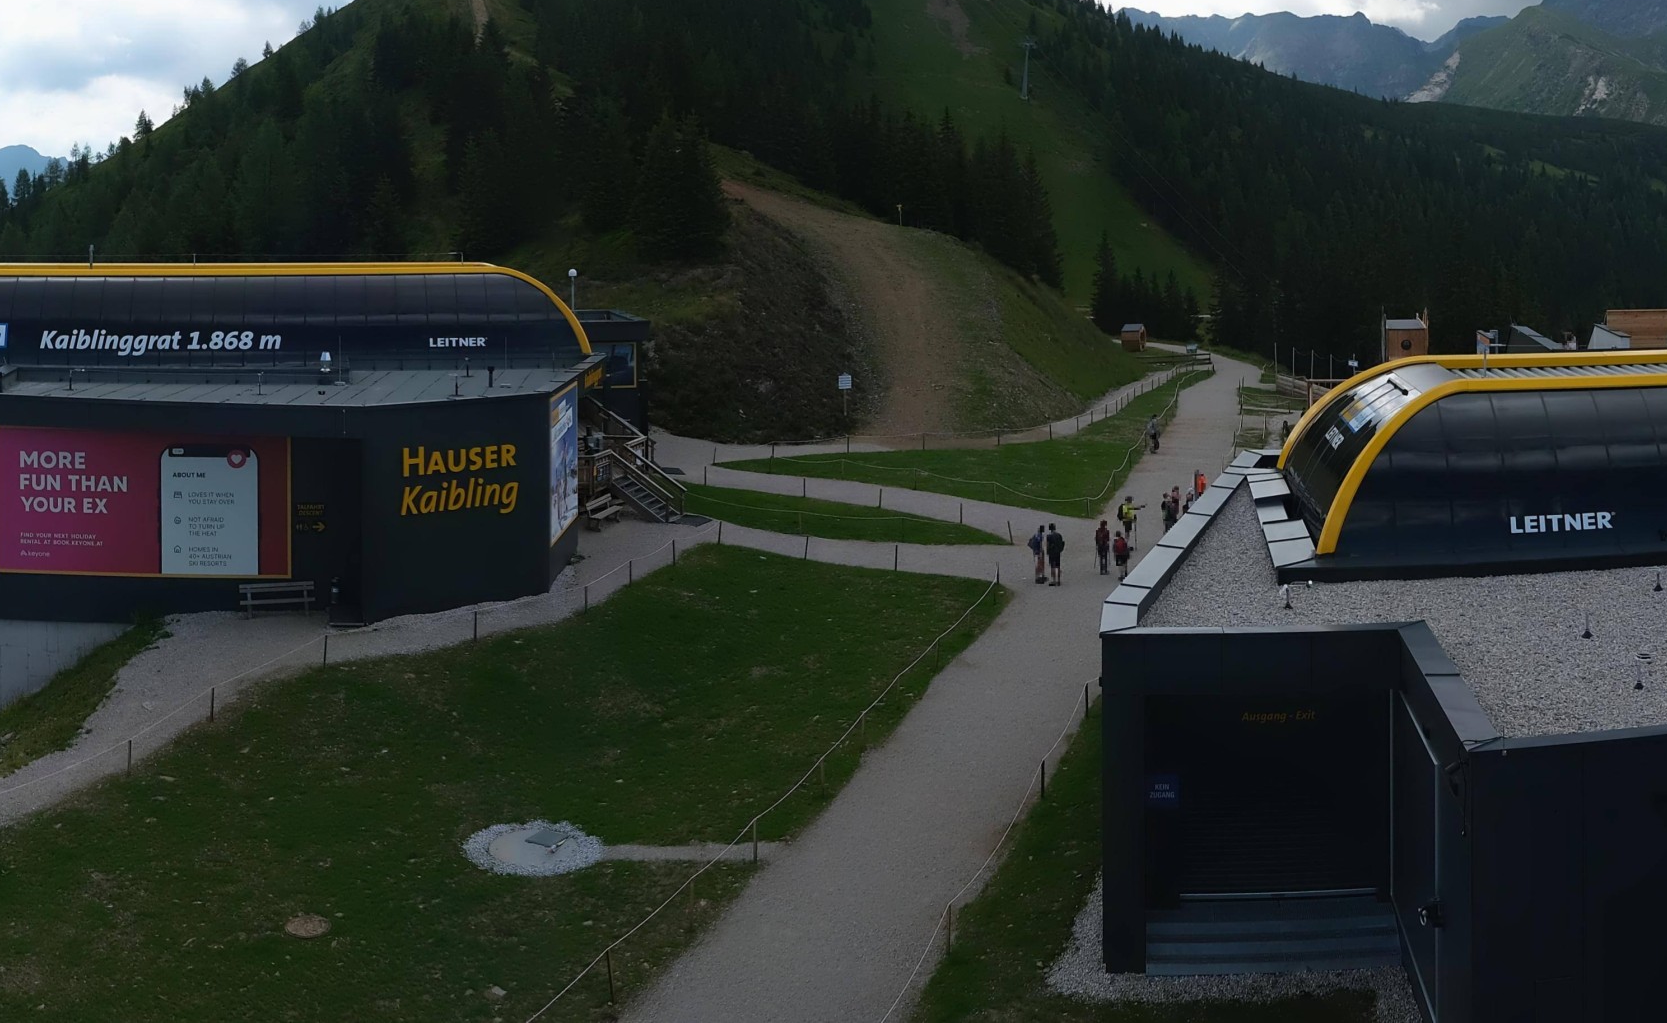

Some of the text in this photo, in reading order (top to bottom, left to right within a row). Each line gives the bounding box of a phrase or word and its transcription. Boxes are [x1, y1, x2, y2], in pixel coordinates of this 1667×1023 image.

[39, 329, 282, 356] Kaiblinggrat 1.868 m
[429, 337, 488, 347] LEITNER
[20, 451, 86, 469] MORE
[403, 444, 517, 478] HAUSER
[20, 474, 128, 492] FUN THAN
[21, 496, 108, 514] YOUR EX
[401, 478, 519, 516] Kaibling
[1510, 511, 1616, 534] LEITNER
[1241, 711, 1288, 724] Ausgang
[1295, 709, 1316, 721] Exit
[1149, 791, 1175, 799] ZUGANG
[1154, 783, 1170, 791] KEIN
